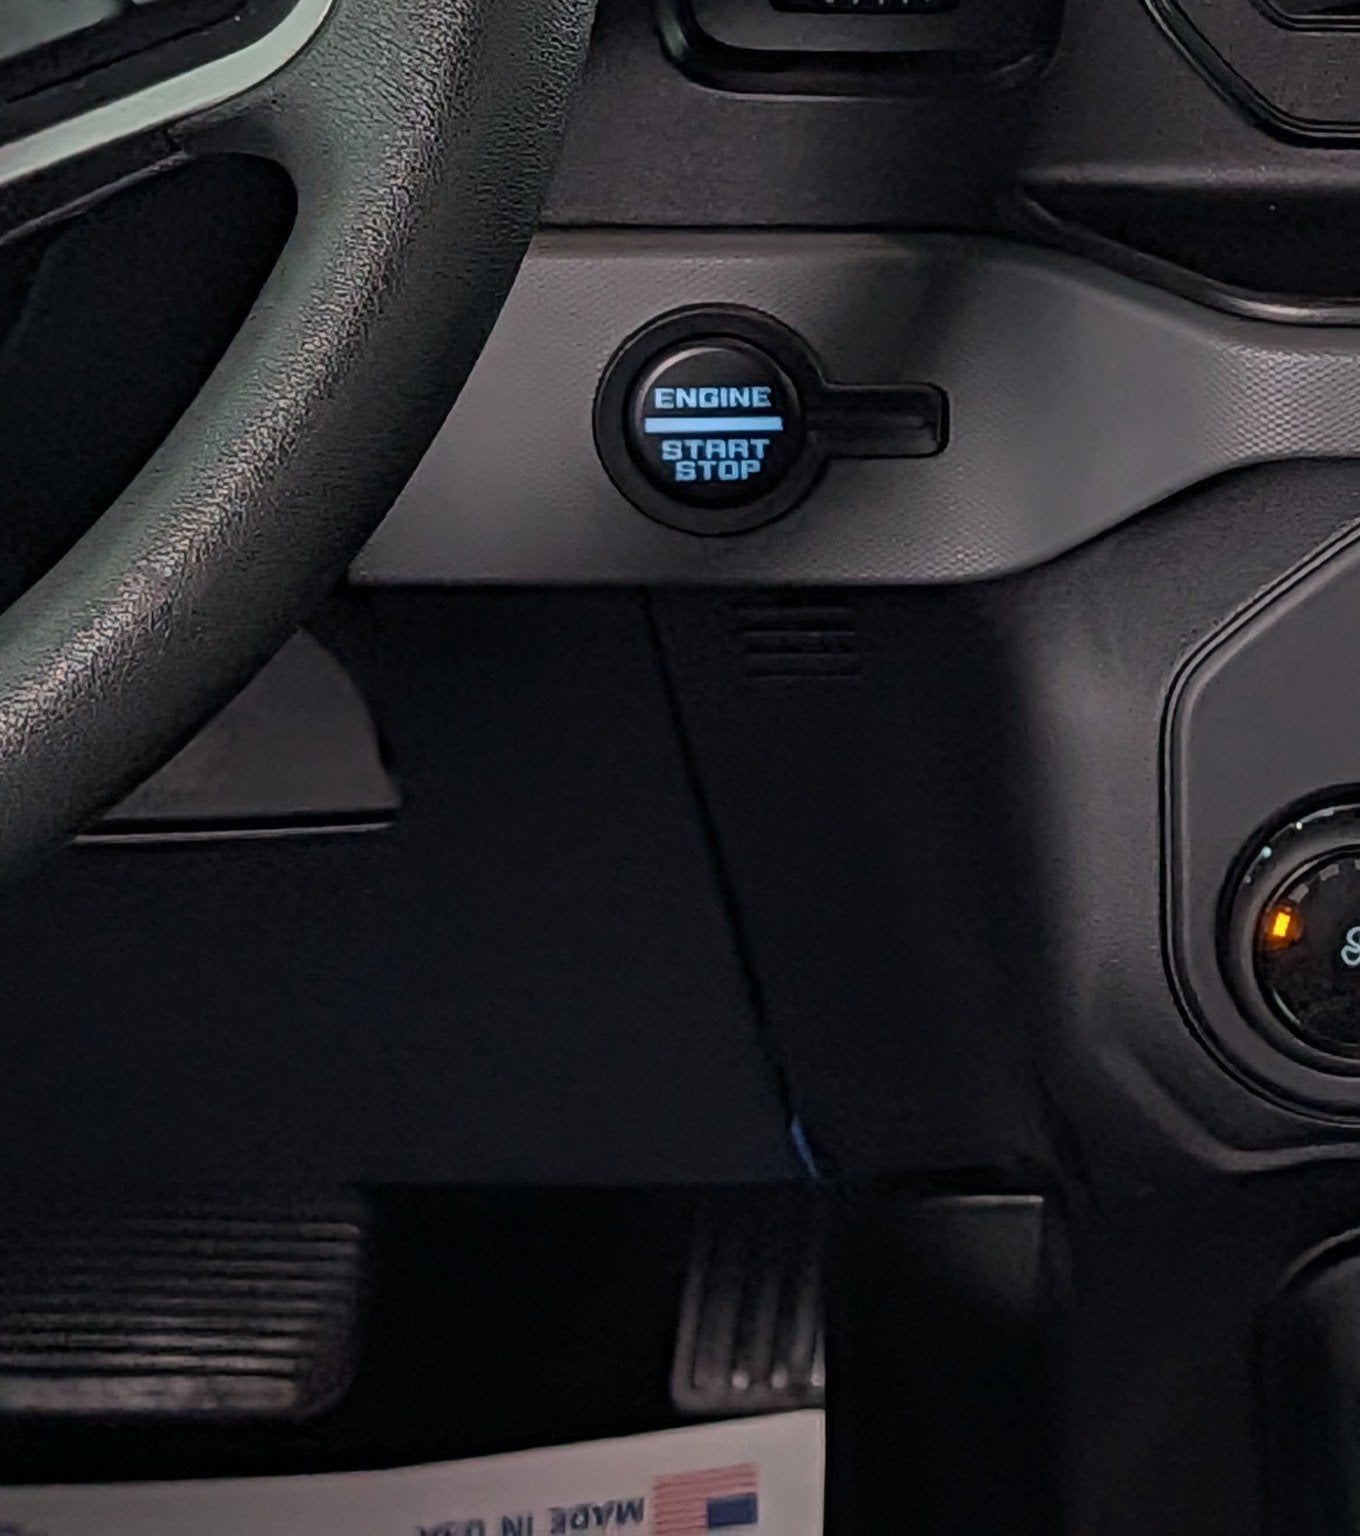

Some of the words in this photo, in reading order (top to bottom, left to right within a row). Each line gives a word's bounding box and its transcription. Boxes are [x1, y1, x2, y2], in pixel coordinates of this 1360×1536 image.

[654, 386, 771, 409] ENGINE
[661, 438, 770, 460] START
[675, 460, 761, 482] STOP
[549, 1498, 644, 1534] MADE
